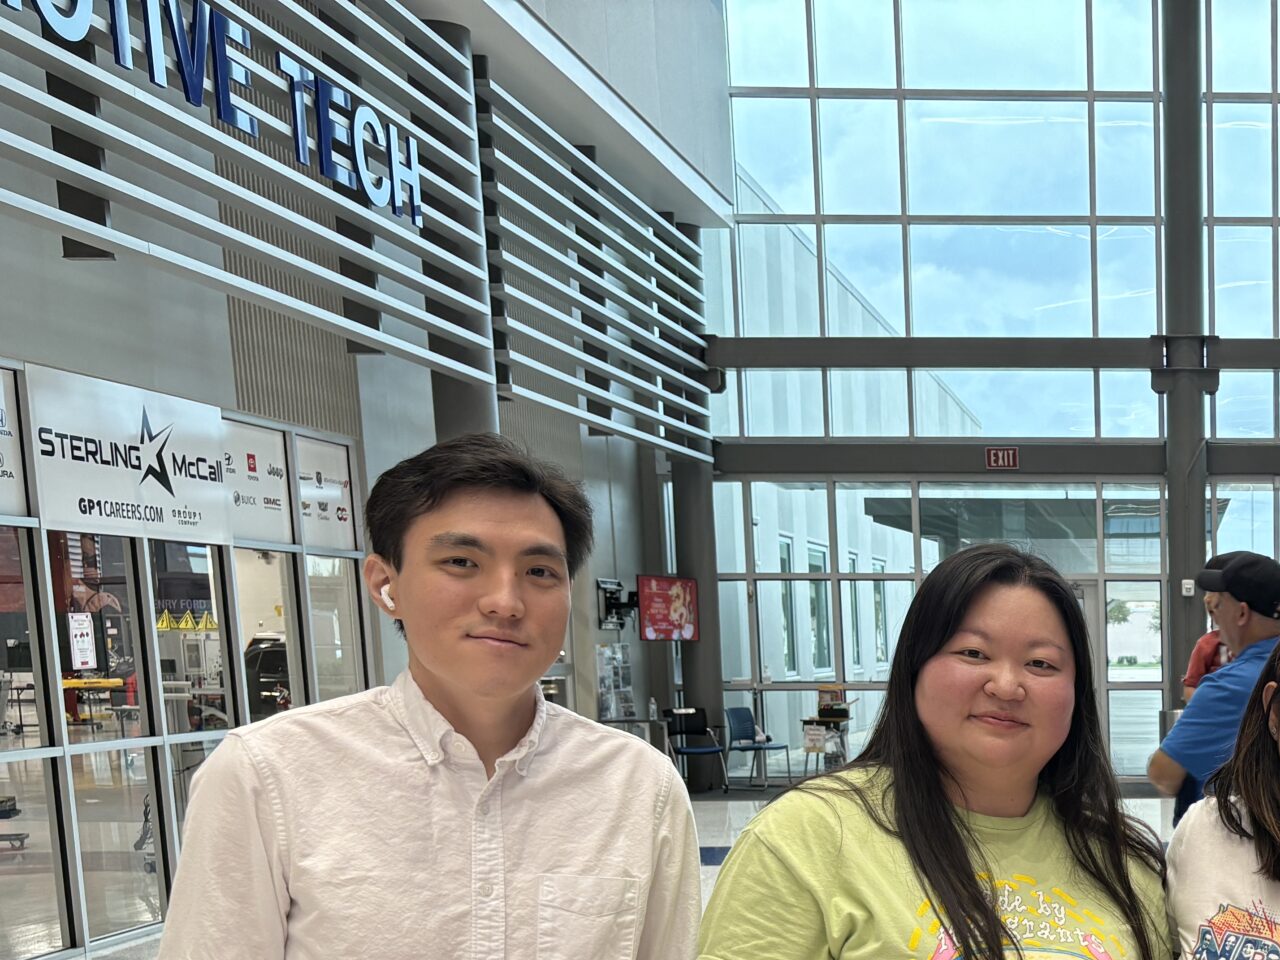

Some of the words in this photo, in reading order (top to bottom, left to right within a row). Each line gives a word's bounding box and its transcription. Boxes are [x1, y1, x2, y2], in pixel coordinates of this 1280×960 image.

[0, 0, 259, 140] TIVE
[277, 51, 423, 229] TECH
[38, 426, 142, 470] STERLING
[172, 452, 223, 483] McCall
[990, 450, 1014, 467] EXIT
[78, 497, 164, 523] GP1CAREERS.COM
[241, 495, 257, 506] BUICK
[263, 497, 281, 507] GMC
[180, 600, 207, 610] FORD
[1038, 890, 1066, 925] by
